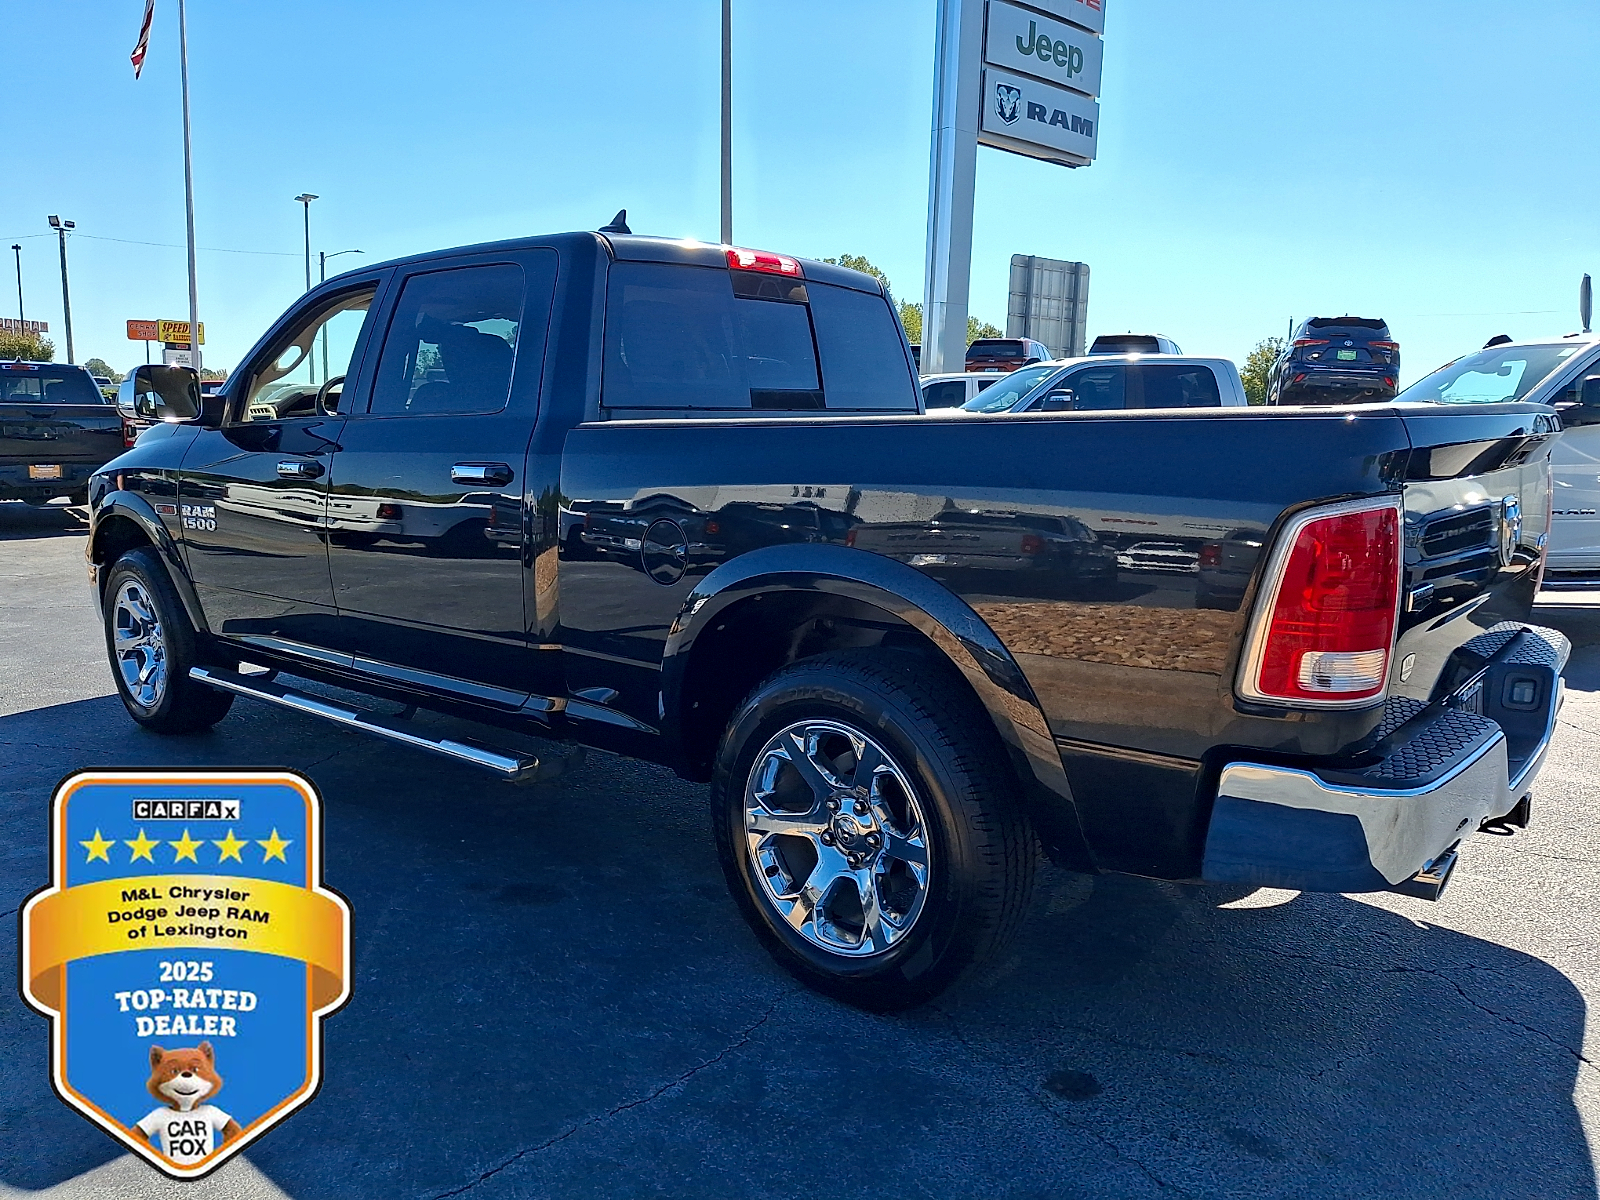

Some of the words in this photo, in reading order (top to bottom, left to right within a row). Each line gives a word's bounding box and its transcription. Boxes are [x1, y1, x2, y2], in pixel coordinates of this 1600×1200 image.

[1016, 20, 1083, 78] Jeep
[1027, 100, 1093, 138] RAM
[181, 504, 216, 518] RAM
[182, 517, 217, 532] 1500
